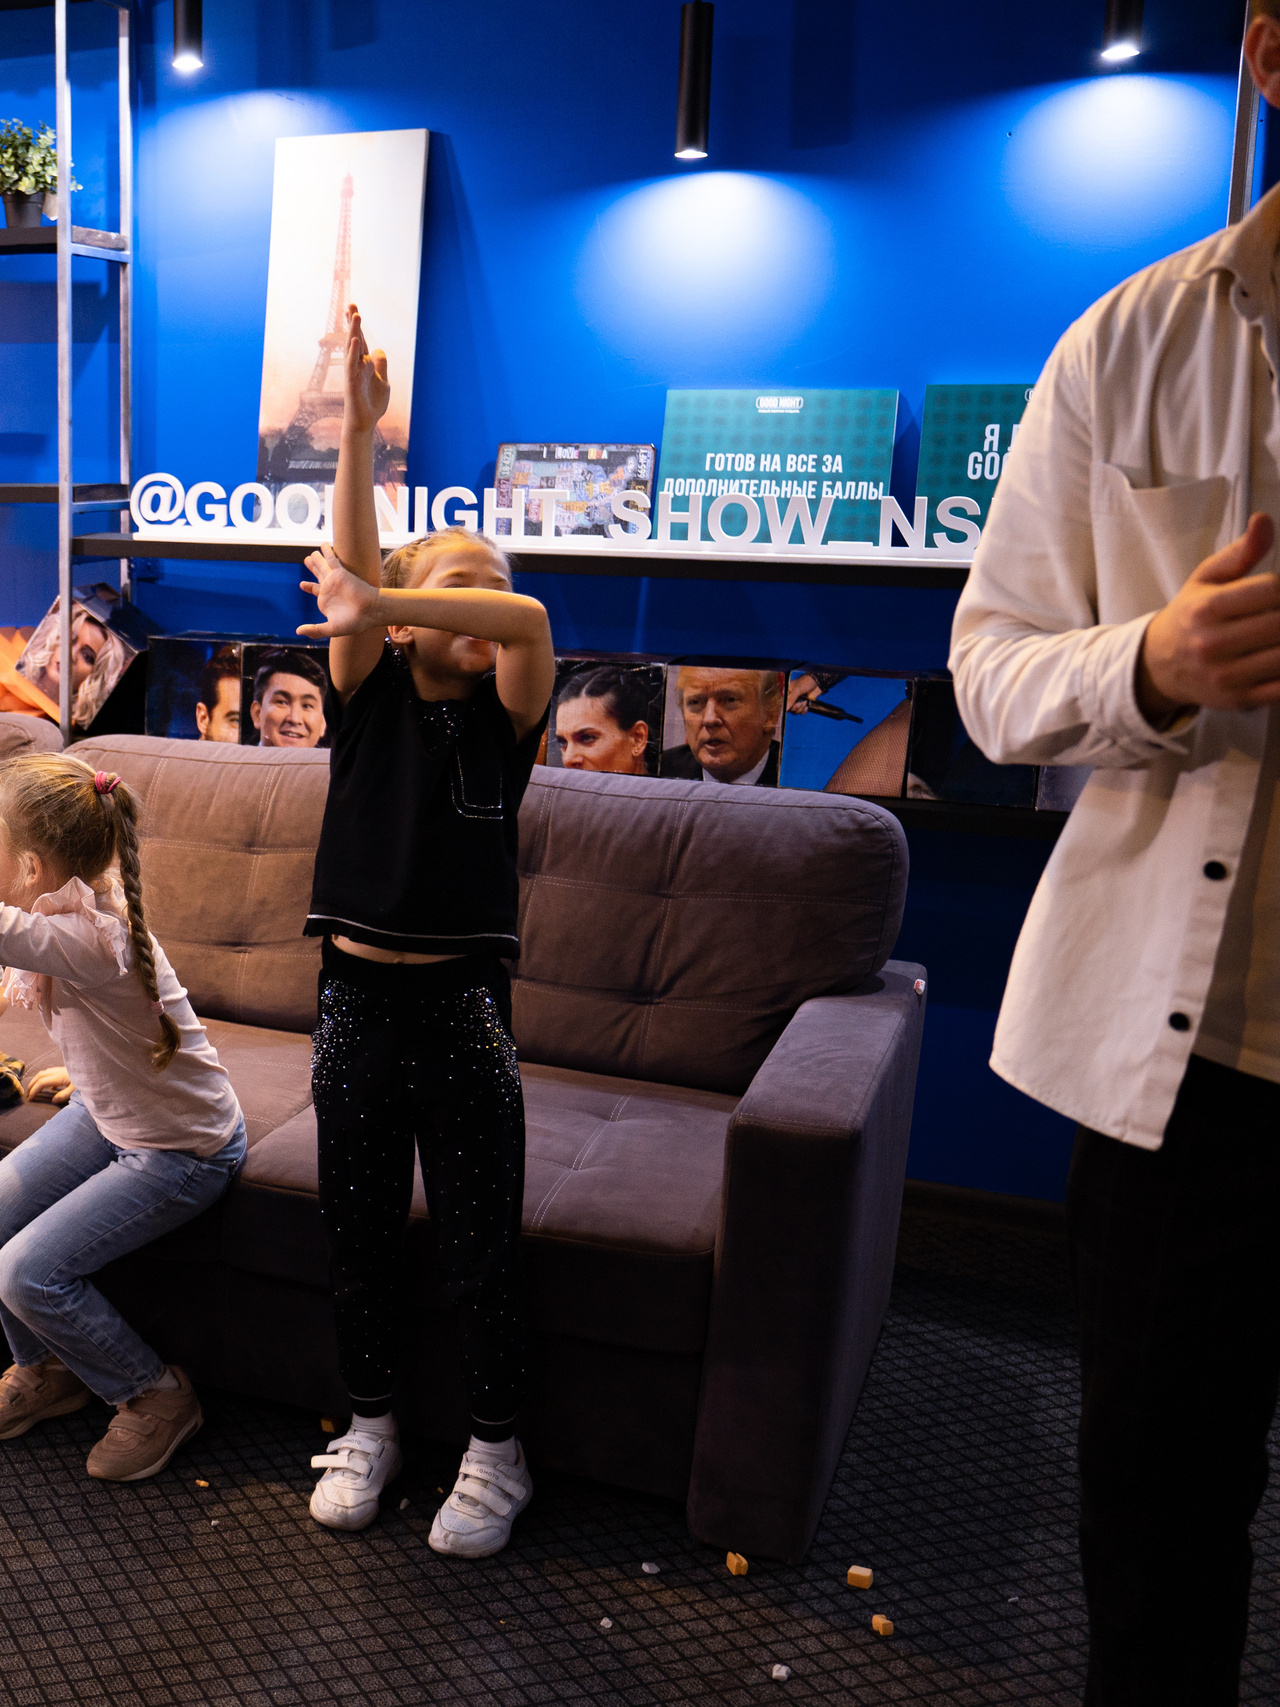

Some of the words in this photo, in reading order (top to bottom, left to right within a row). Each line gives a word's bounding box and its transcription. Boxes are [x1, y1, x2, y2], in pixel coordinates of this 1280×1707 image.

[983, 424, 1000, 452] Я
[705, 453, 755, 472] ГОТОВ
[759, 453, 781, 472] НА
[786, 454, 817, 473] ВСЕ
[822, 454, 843, 473] ЗА
[663, 478, 817, 499] ДОПОЛНИТЕЛЬНЫЕ
[822, 480, 884, 500] БАЛЛЫ
